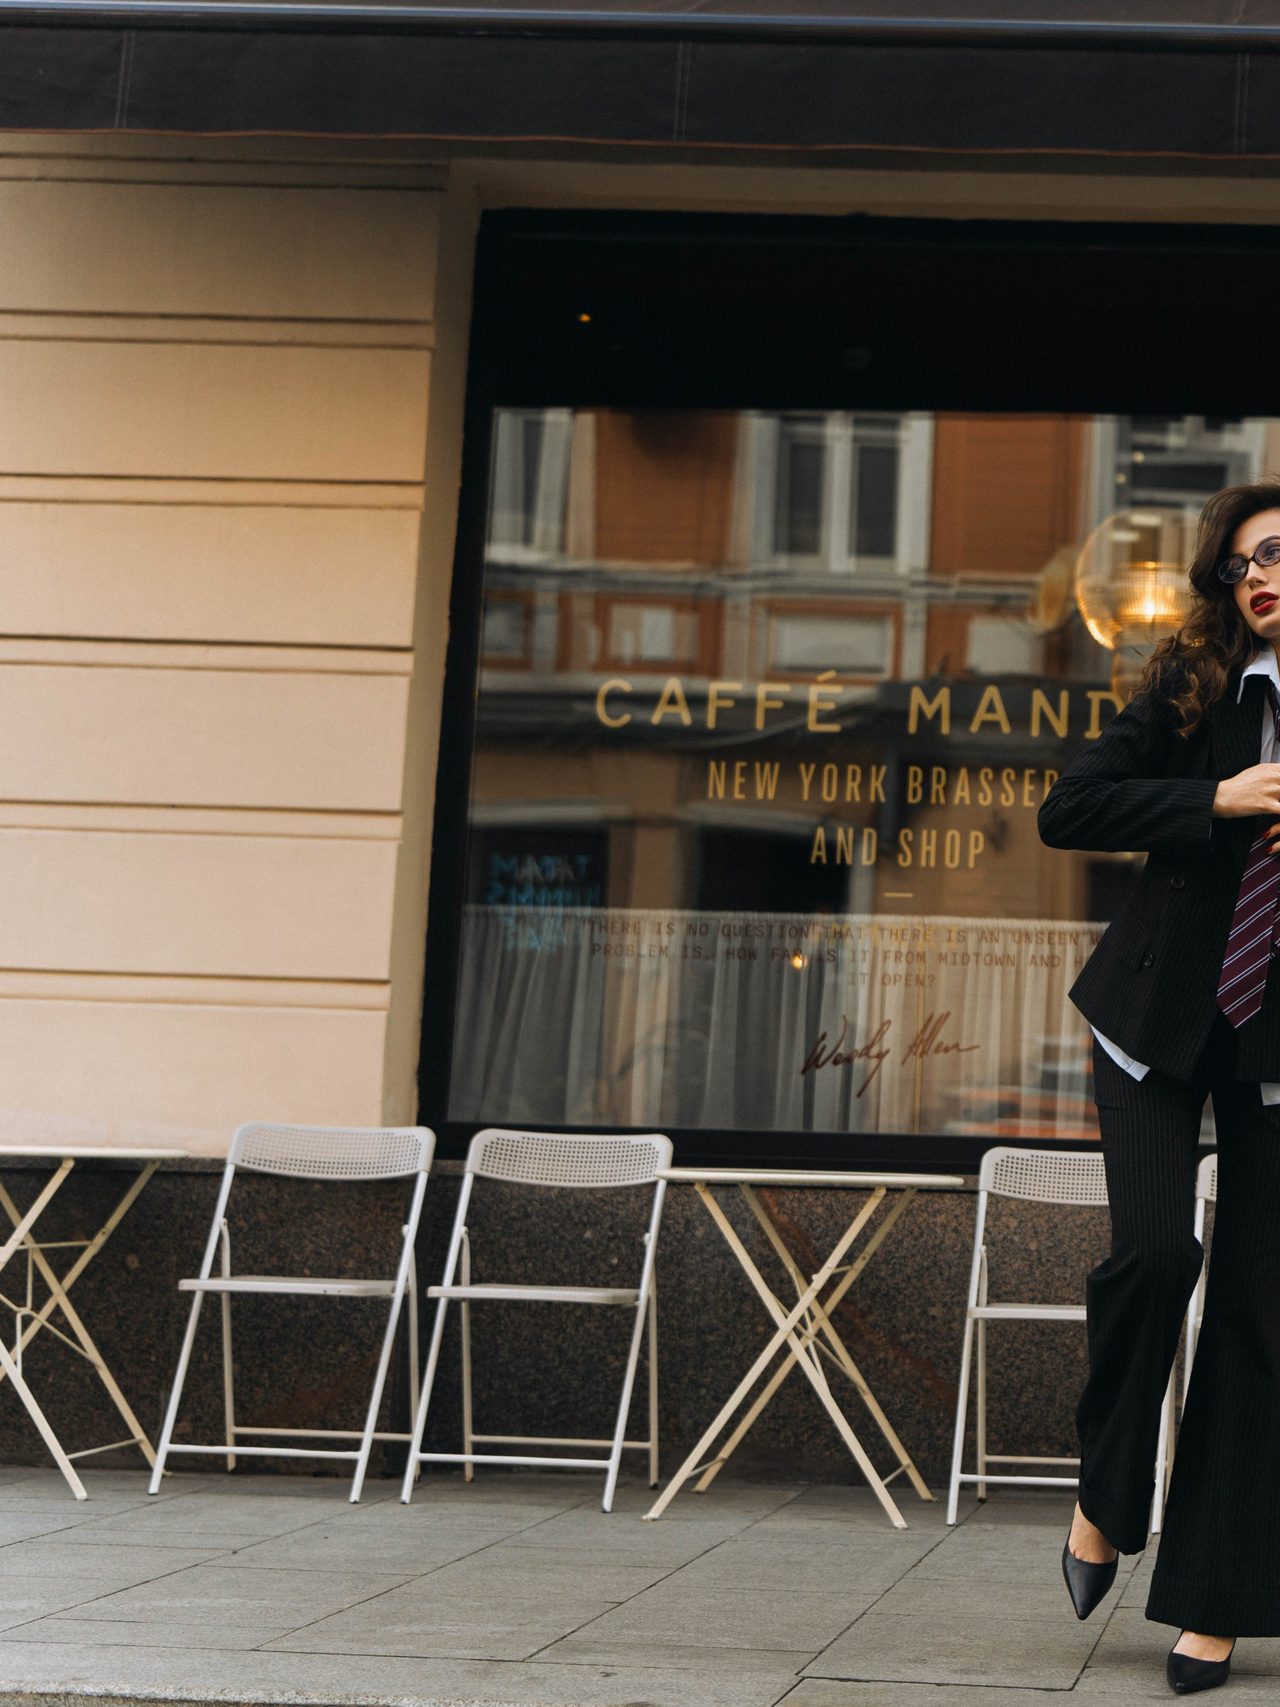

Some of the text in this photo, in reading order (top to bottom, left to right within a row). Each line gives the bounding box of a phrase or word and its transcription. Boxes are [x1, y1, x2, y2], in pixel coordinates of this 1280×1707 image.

[595, 670, 844, 733] CAFFÉ
[707, 760, 780, 802] NEW
[800, 763, 888, 804] YORK
[811, 826, 986, 869] AND SHOP
[588, 919, 642, 936] THERE
[656, 921, 676, 936] IS
[688, 922, 710, 937] NO
[721, 923, 811, 939] QUESTION
[947, 927, 967, 942] IS
[979, 928, 1001, 944] AN
[1012, 928, 1079, 946] UNSEEN
[726, 947, 758, 961] HOW
[848, 949, 870, 963] IT
[884, 950, 926, 965] FROM
[938, 952, 1016, 967] MIDTOWN
[1029, 954, 1062, 969] AND
[848, 972, 936, 988] IT OPEN?
